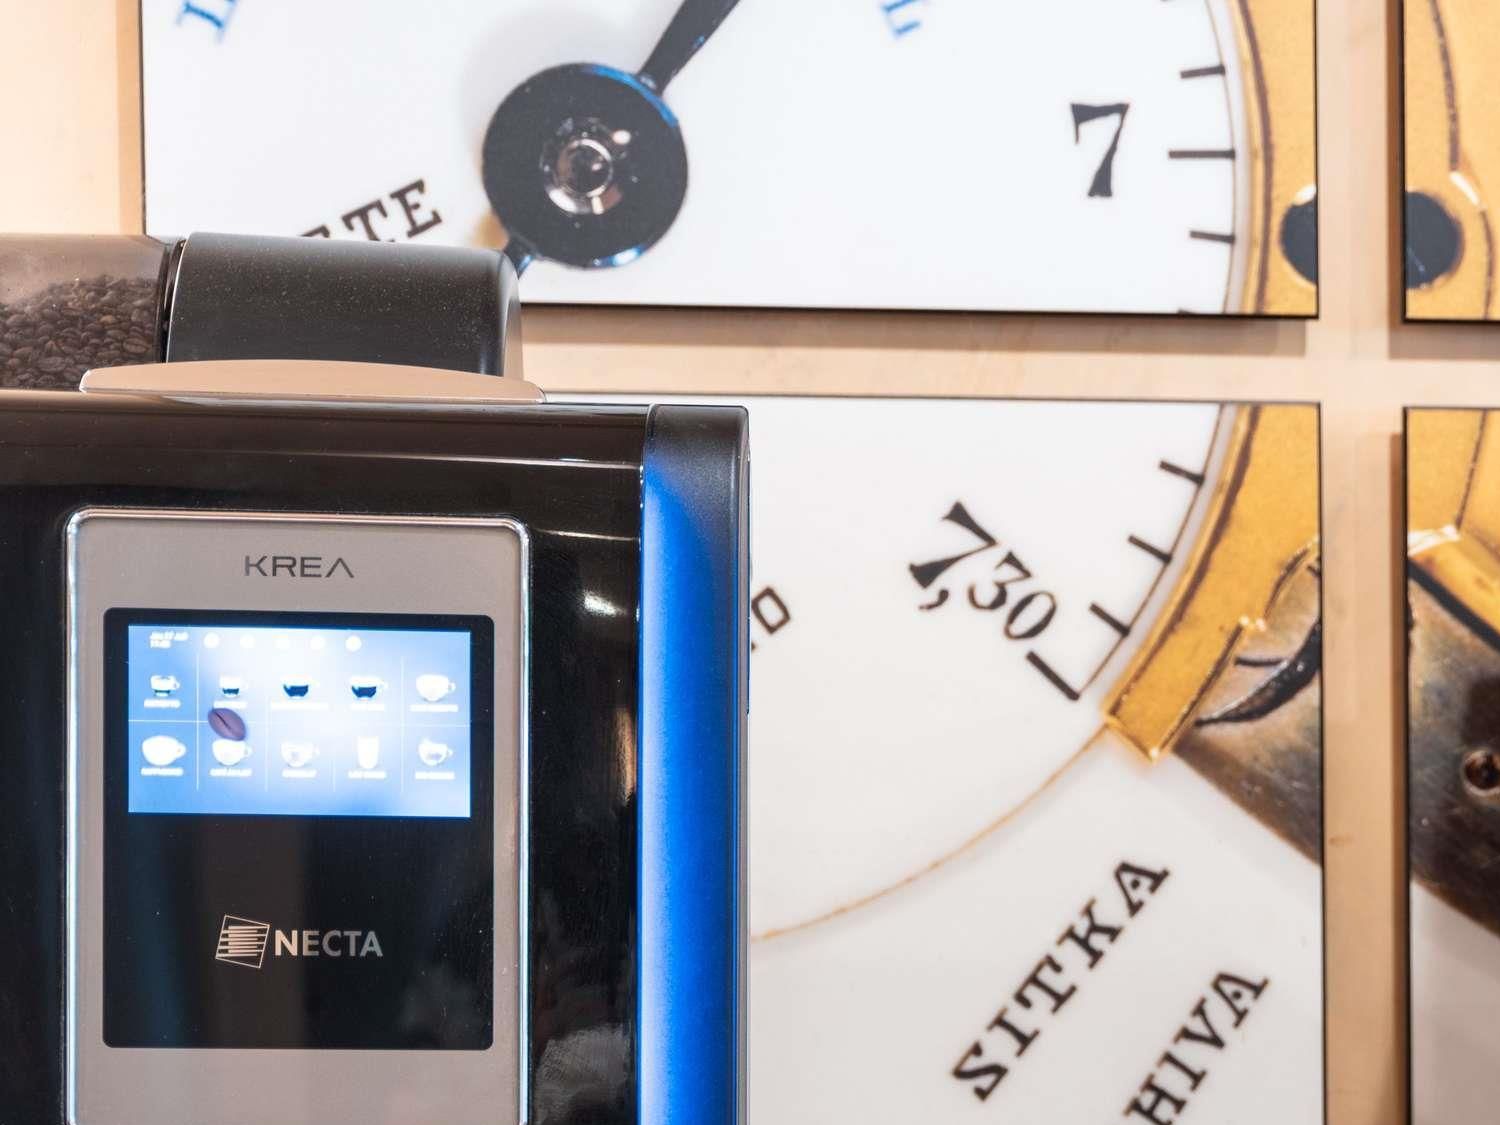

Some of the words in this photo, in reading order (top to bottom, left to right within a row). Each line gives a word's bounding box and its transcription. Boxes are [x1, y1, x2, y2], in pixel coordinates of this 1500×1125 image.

[1069, 101, 1130, 199] 7
[243, 555, 355, 578] KREA
[275, 930, 383, 959] NECTA
[952, 858, 1170, 1101] SITKA
